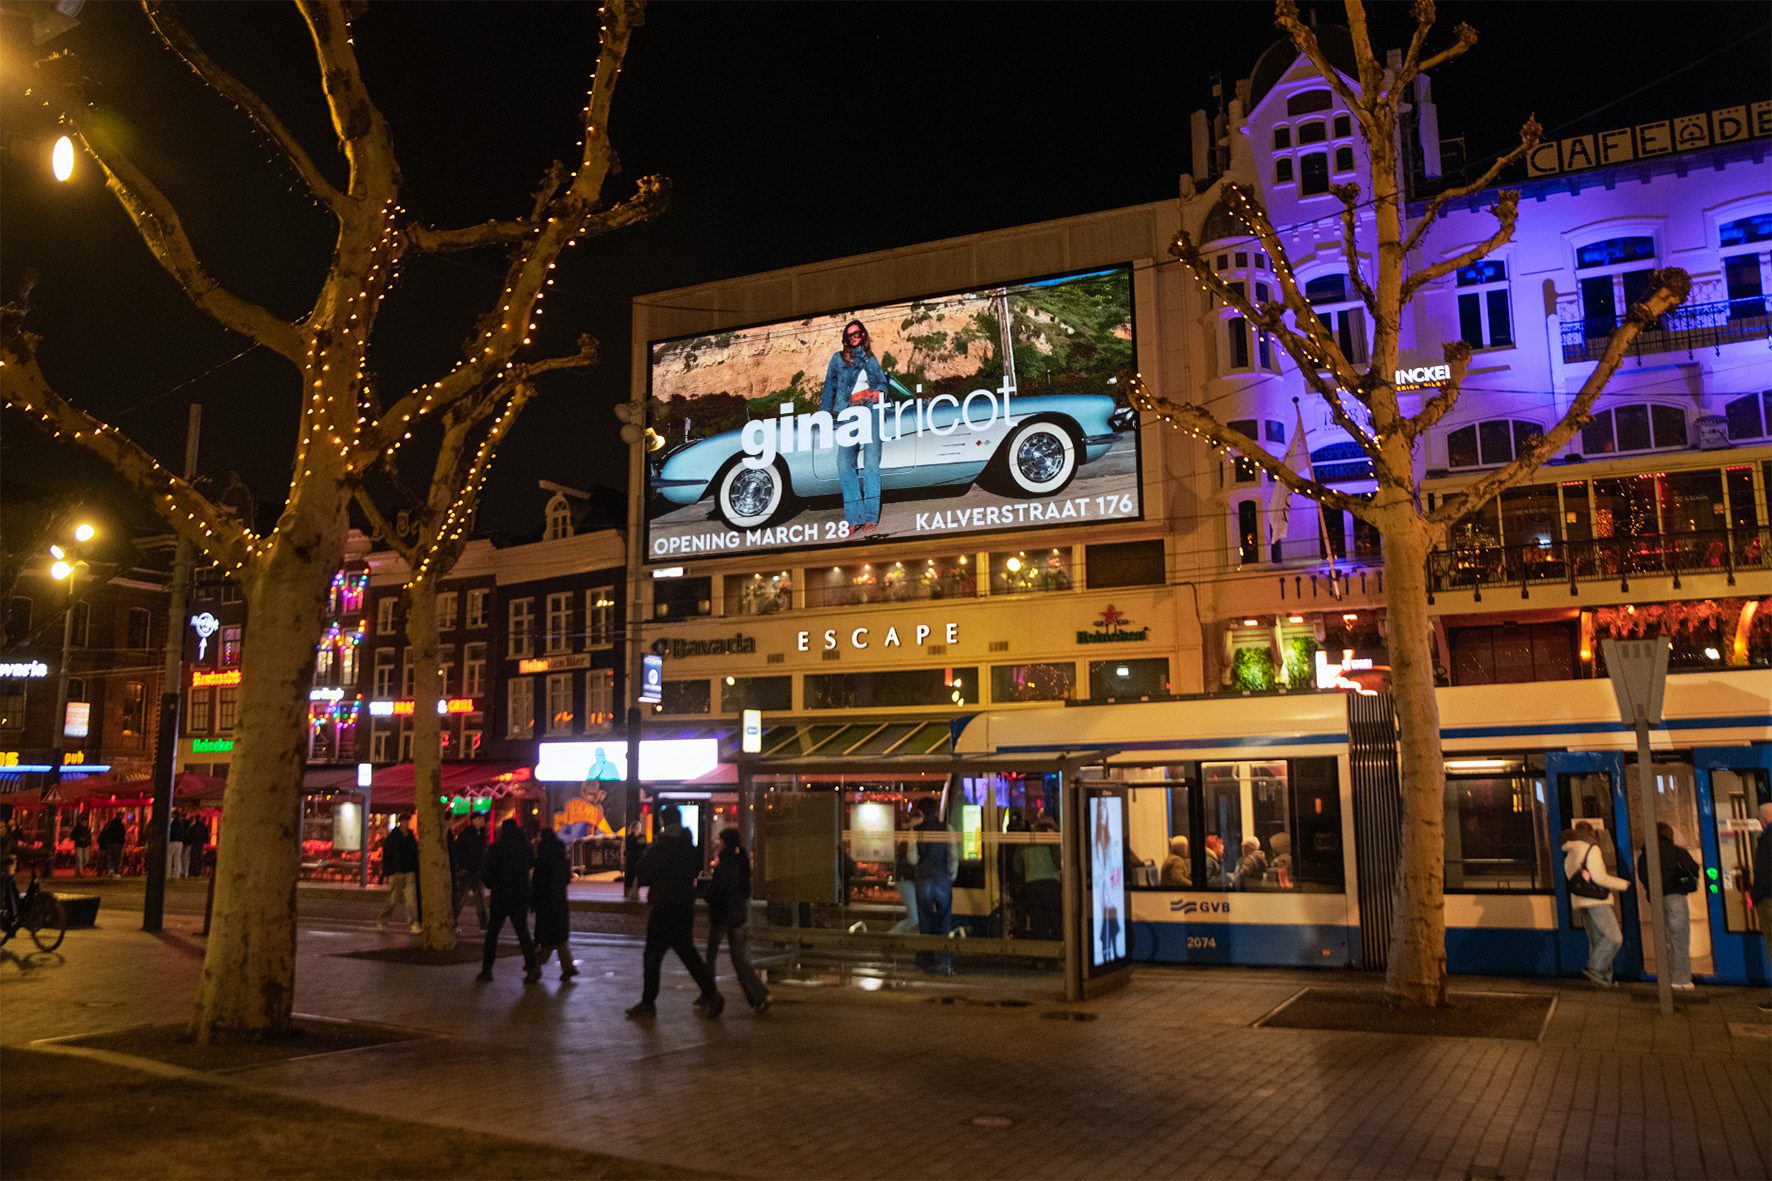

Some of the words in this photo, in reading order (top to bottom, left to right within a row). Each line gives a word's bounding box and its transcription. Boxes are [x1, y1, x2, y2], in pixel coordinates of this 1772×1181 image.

[1530, 123, 1669, 173] CAFE
[1718, 109, 1772, 142] DE
[741, 376, 1018, 470] ginatricot
[915, 498, 1090, 531] KALVERSTRAAT
[1095, 493, 1133, 515] 176
[653, 531, 740, 555] OPENING
[746, 523, 818, 546] MARCH
[825, 520, 850, 540] 28
[673, 633, 756, 659] Bavaria
[798, 623, 958, 651] ESCAPE
[64, 750, 84, 765] pub
[1200, 902, 1230, 913] GVB
[1187, 936, 1217, 948] 2074
